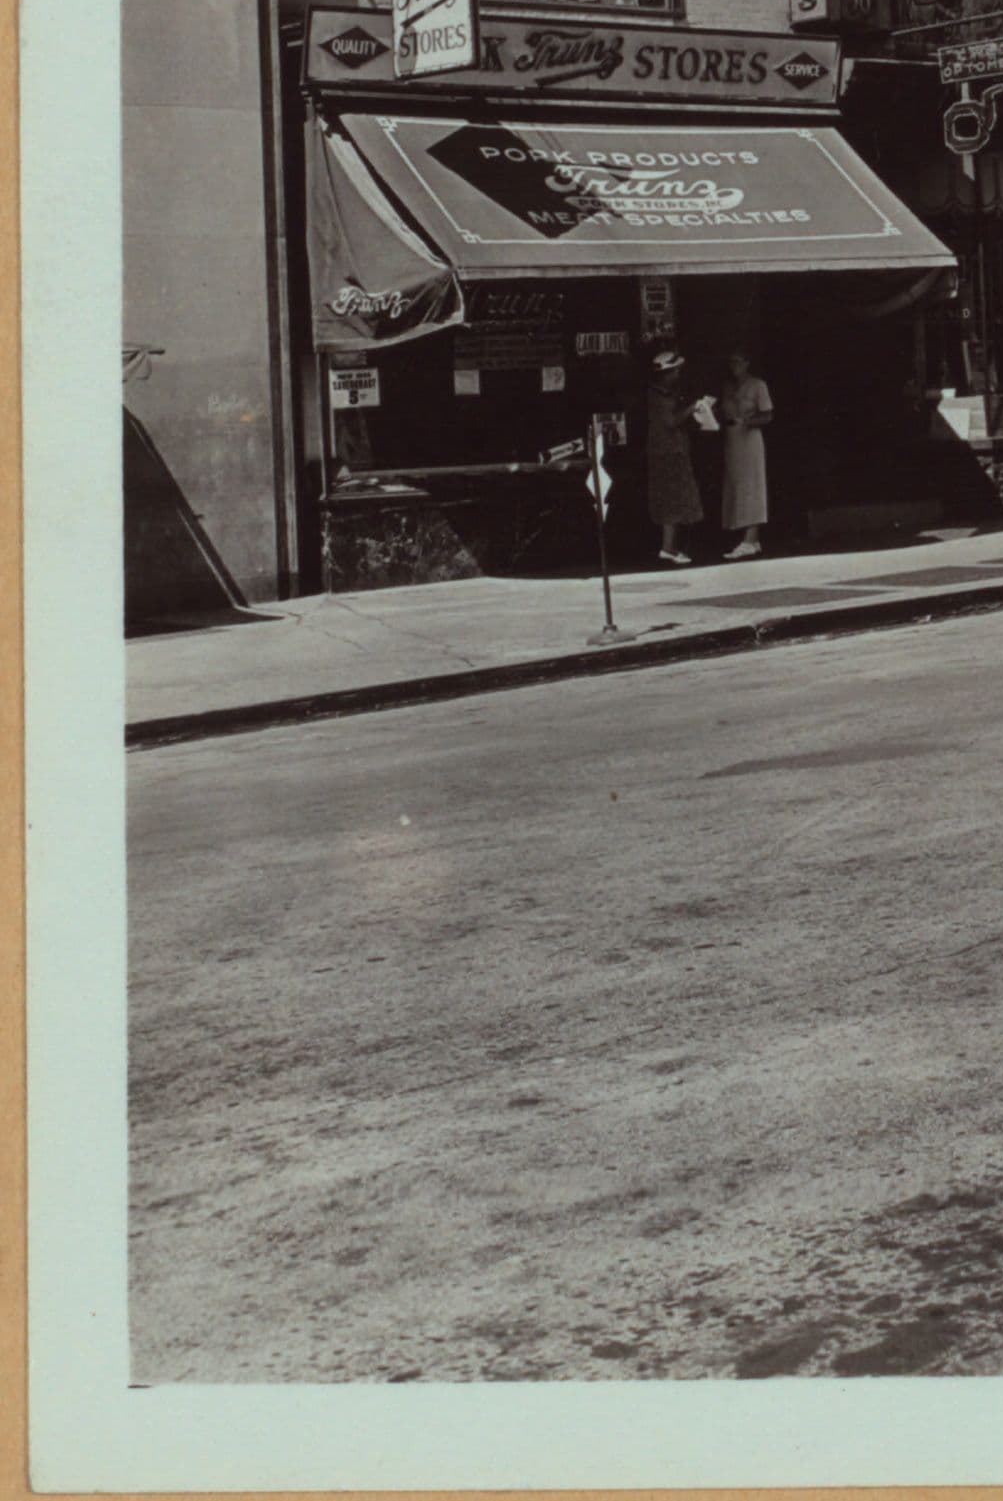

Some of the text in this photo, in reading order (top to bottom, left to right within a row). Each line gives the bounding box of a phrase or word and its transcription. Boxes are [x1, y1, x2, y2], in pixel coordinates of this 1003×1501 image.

[331, 38, 378, 56] QUALITY
[401, 24, 467, 58] STORES
[632, 45, 769, 85] STORES
[783, 62, 821, 78] SERVICE
[479, 145, 761, 167] PORK PRODUCTS
[526, 207, 812, 228] MEAT SPECIALTIES
